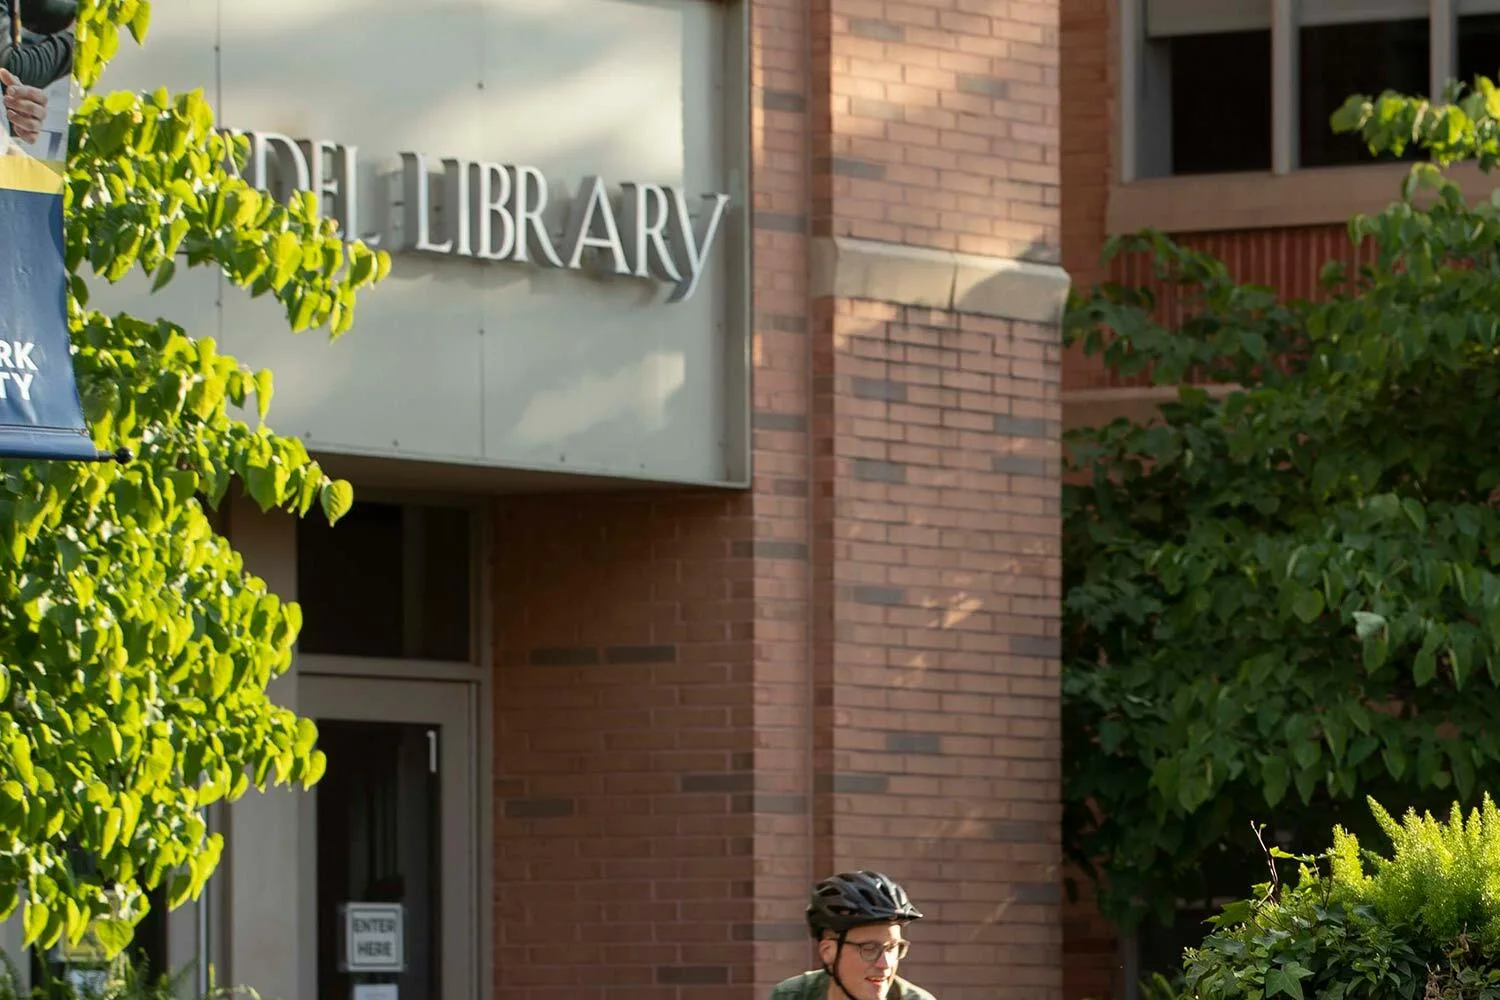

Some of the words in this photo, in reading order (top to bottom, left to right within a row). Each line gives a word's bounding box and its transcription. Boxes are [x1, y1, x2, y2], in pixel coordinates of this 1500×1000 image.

[214, 128, 382, 246] DEL
[406, 152, 730, 303] LIBRARY
[352, 917, 397, 933] ENTER
[357, 940, 393, 957] HERE
